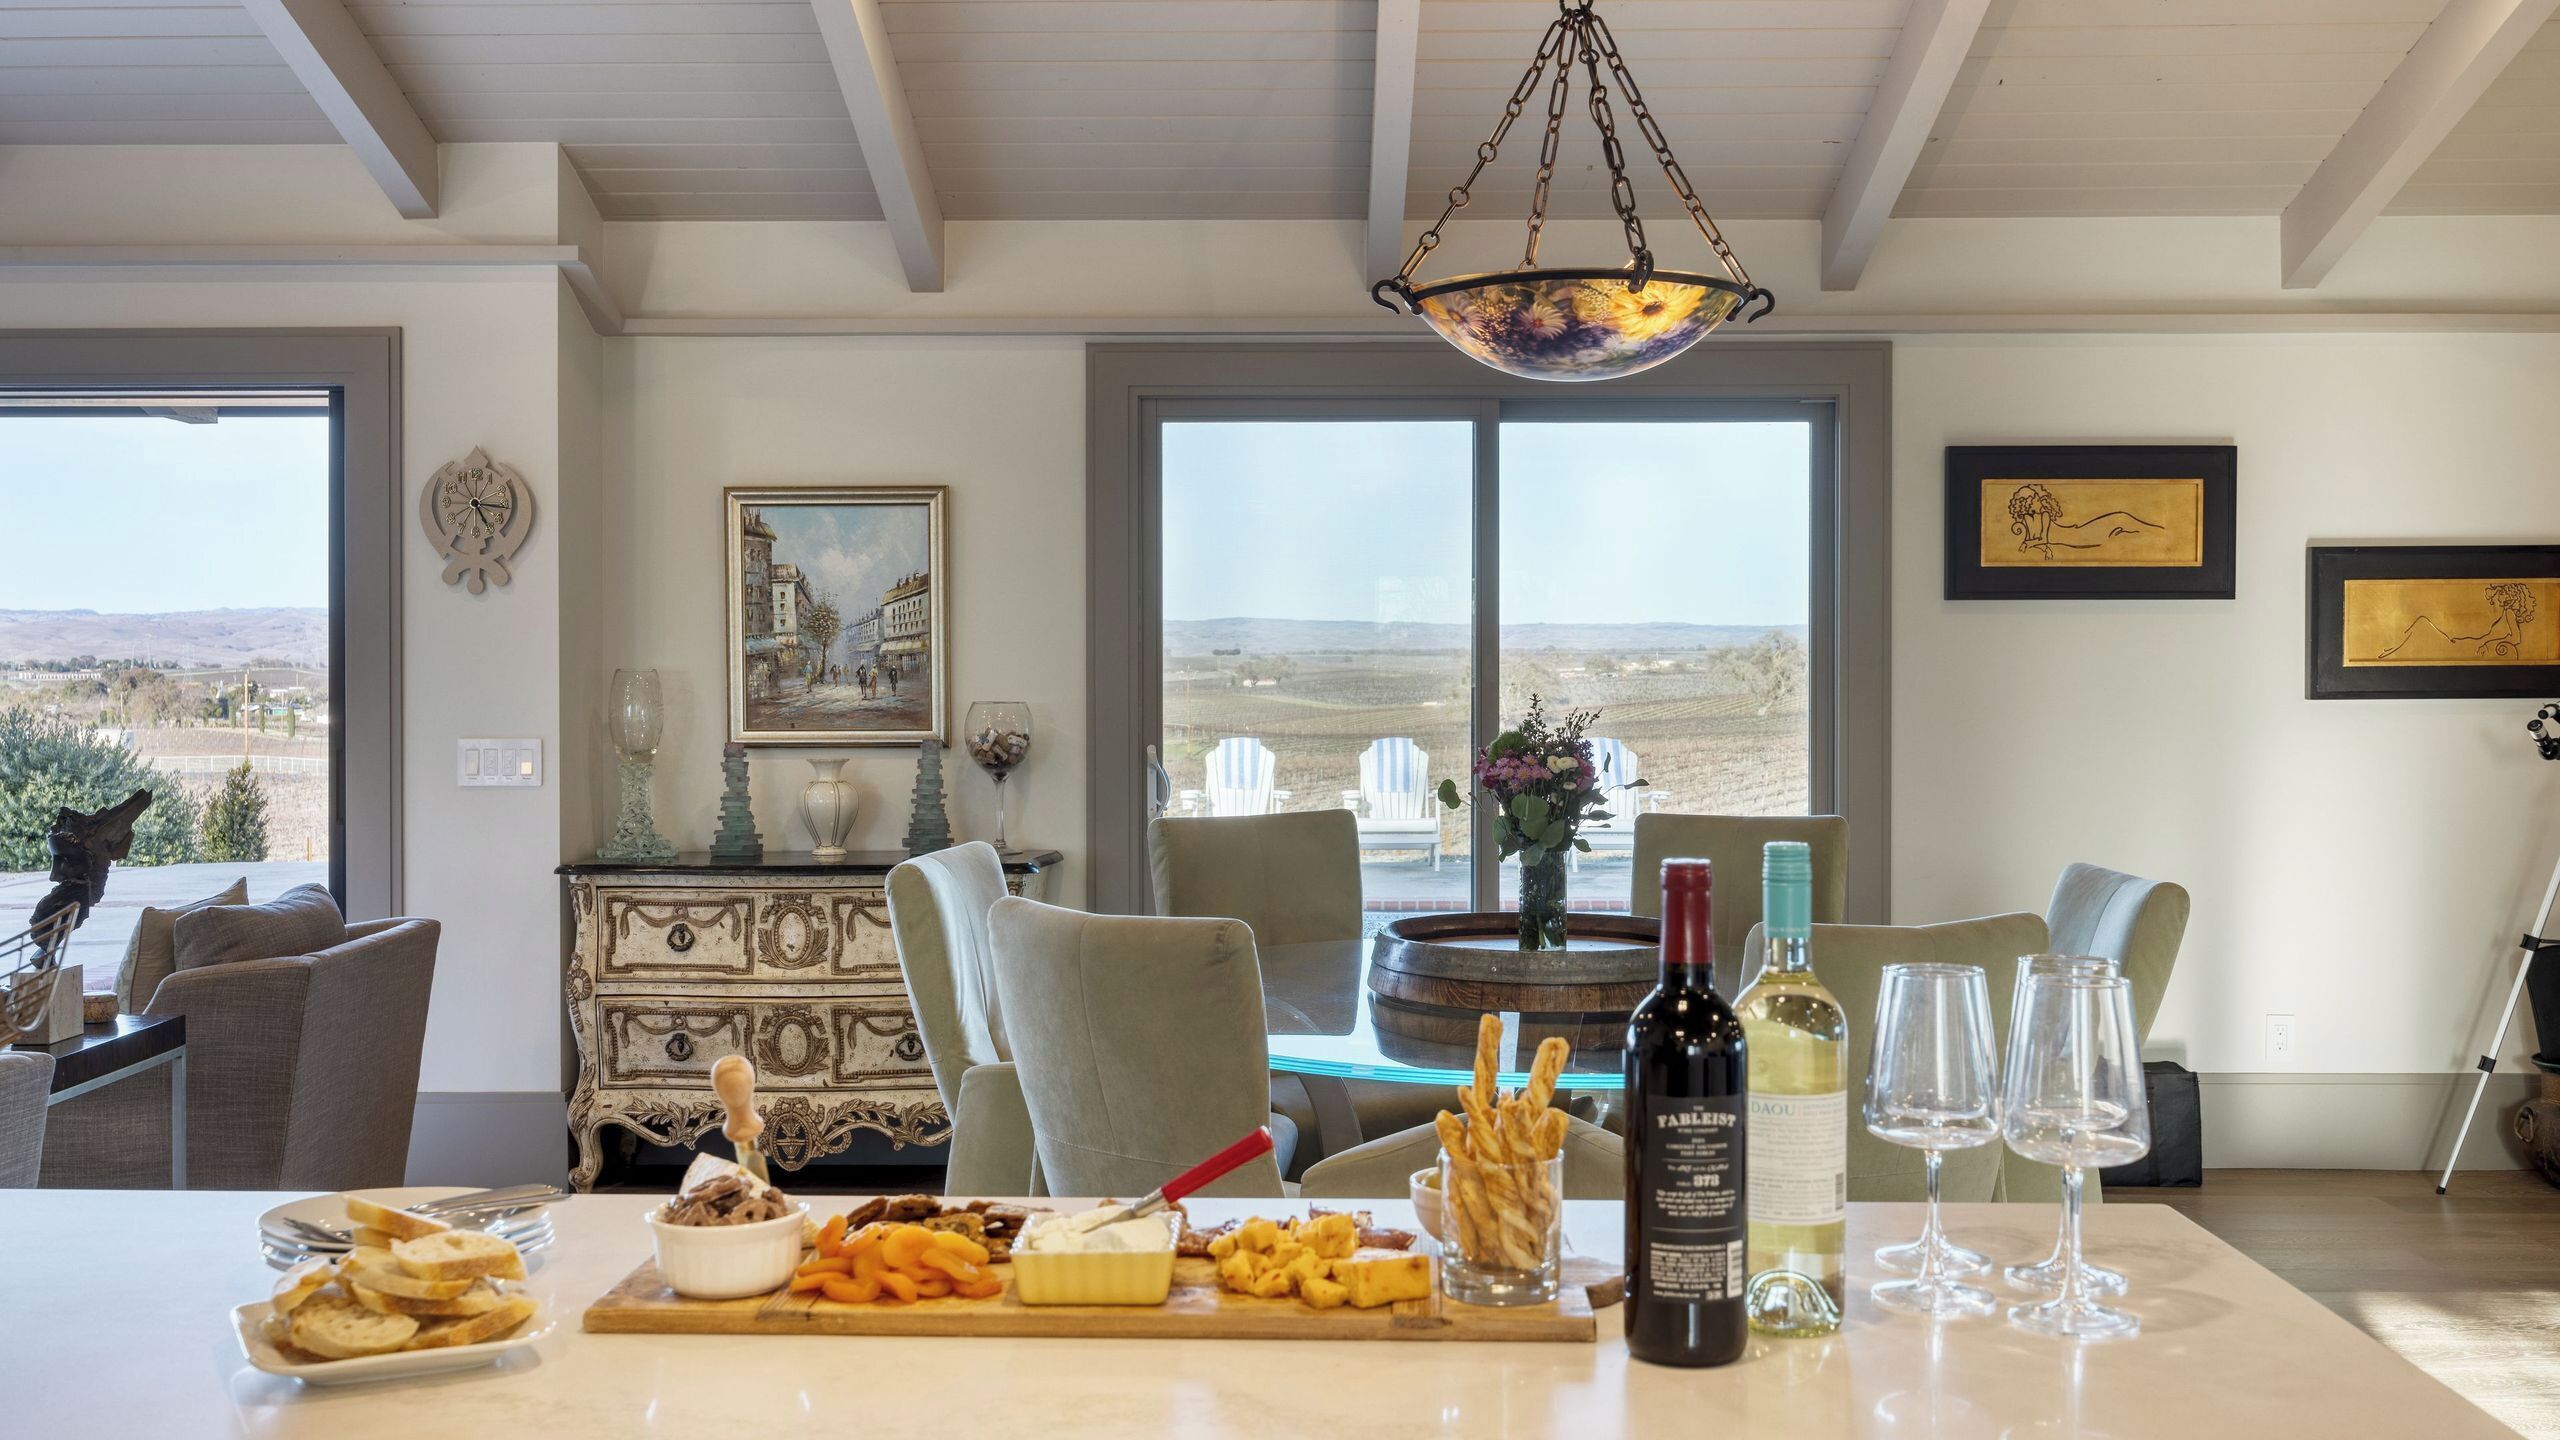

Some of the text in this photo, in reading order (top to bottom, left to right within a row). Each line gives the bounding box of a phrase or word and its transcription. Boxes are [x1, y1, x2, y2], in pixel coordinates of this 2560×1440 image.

[468, 468, 483, 481] 12
[443, 481, 458, 494] 10
[496, 484, 506, 497] 2
[456, 521, 466, 535] 7
[1751, 1101, 1796, 1116] DAOU
[1656, 1112, 1737, 1129] FABLEIST
